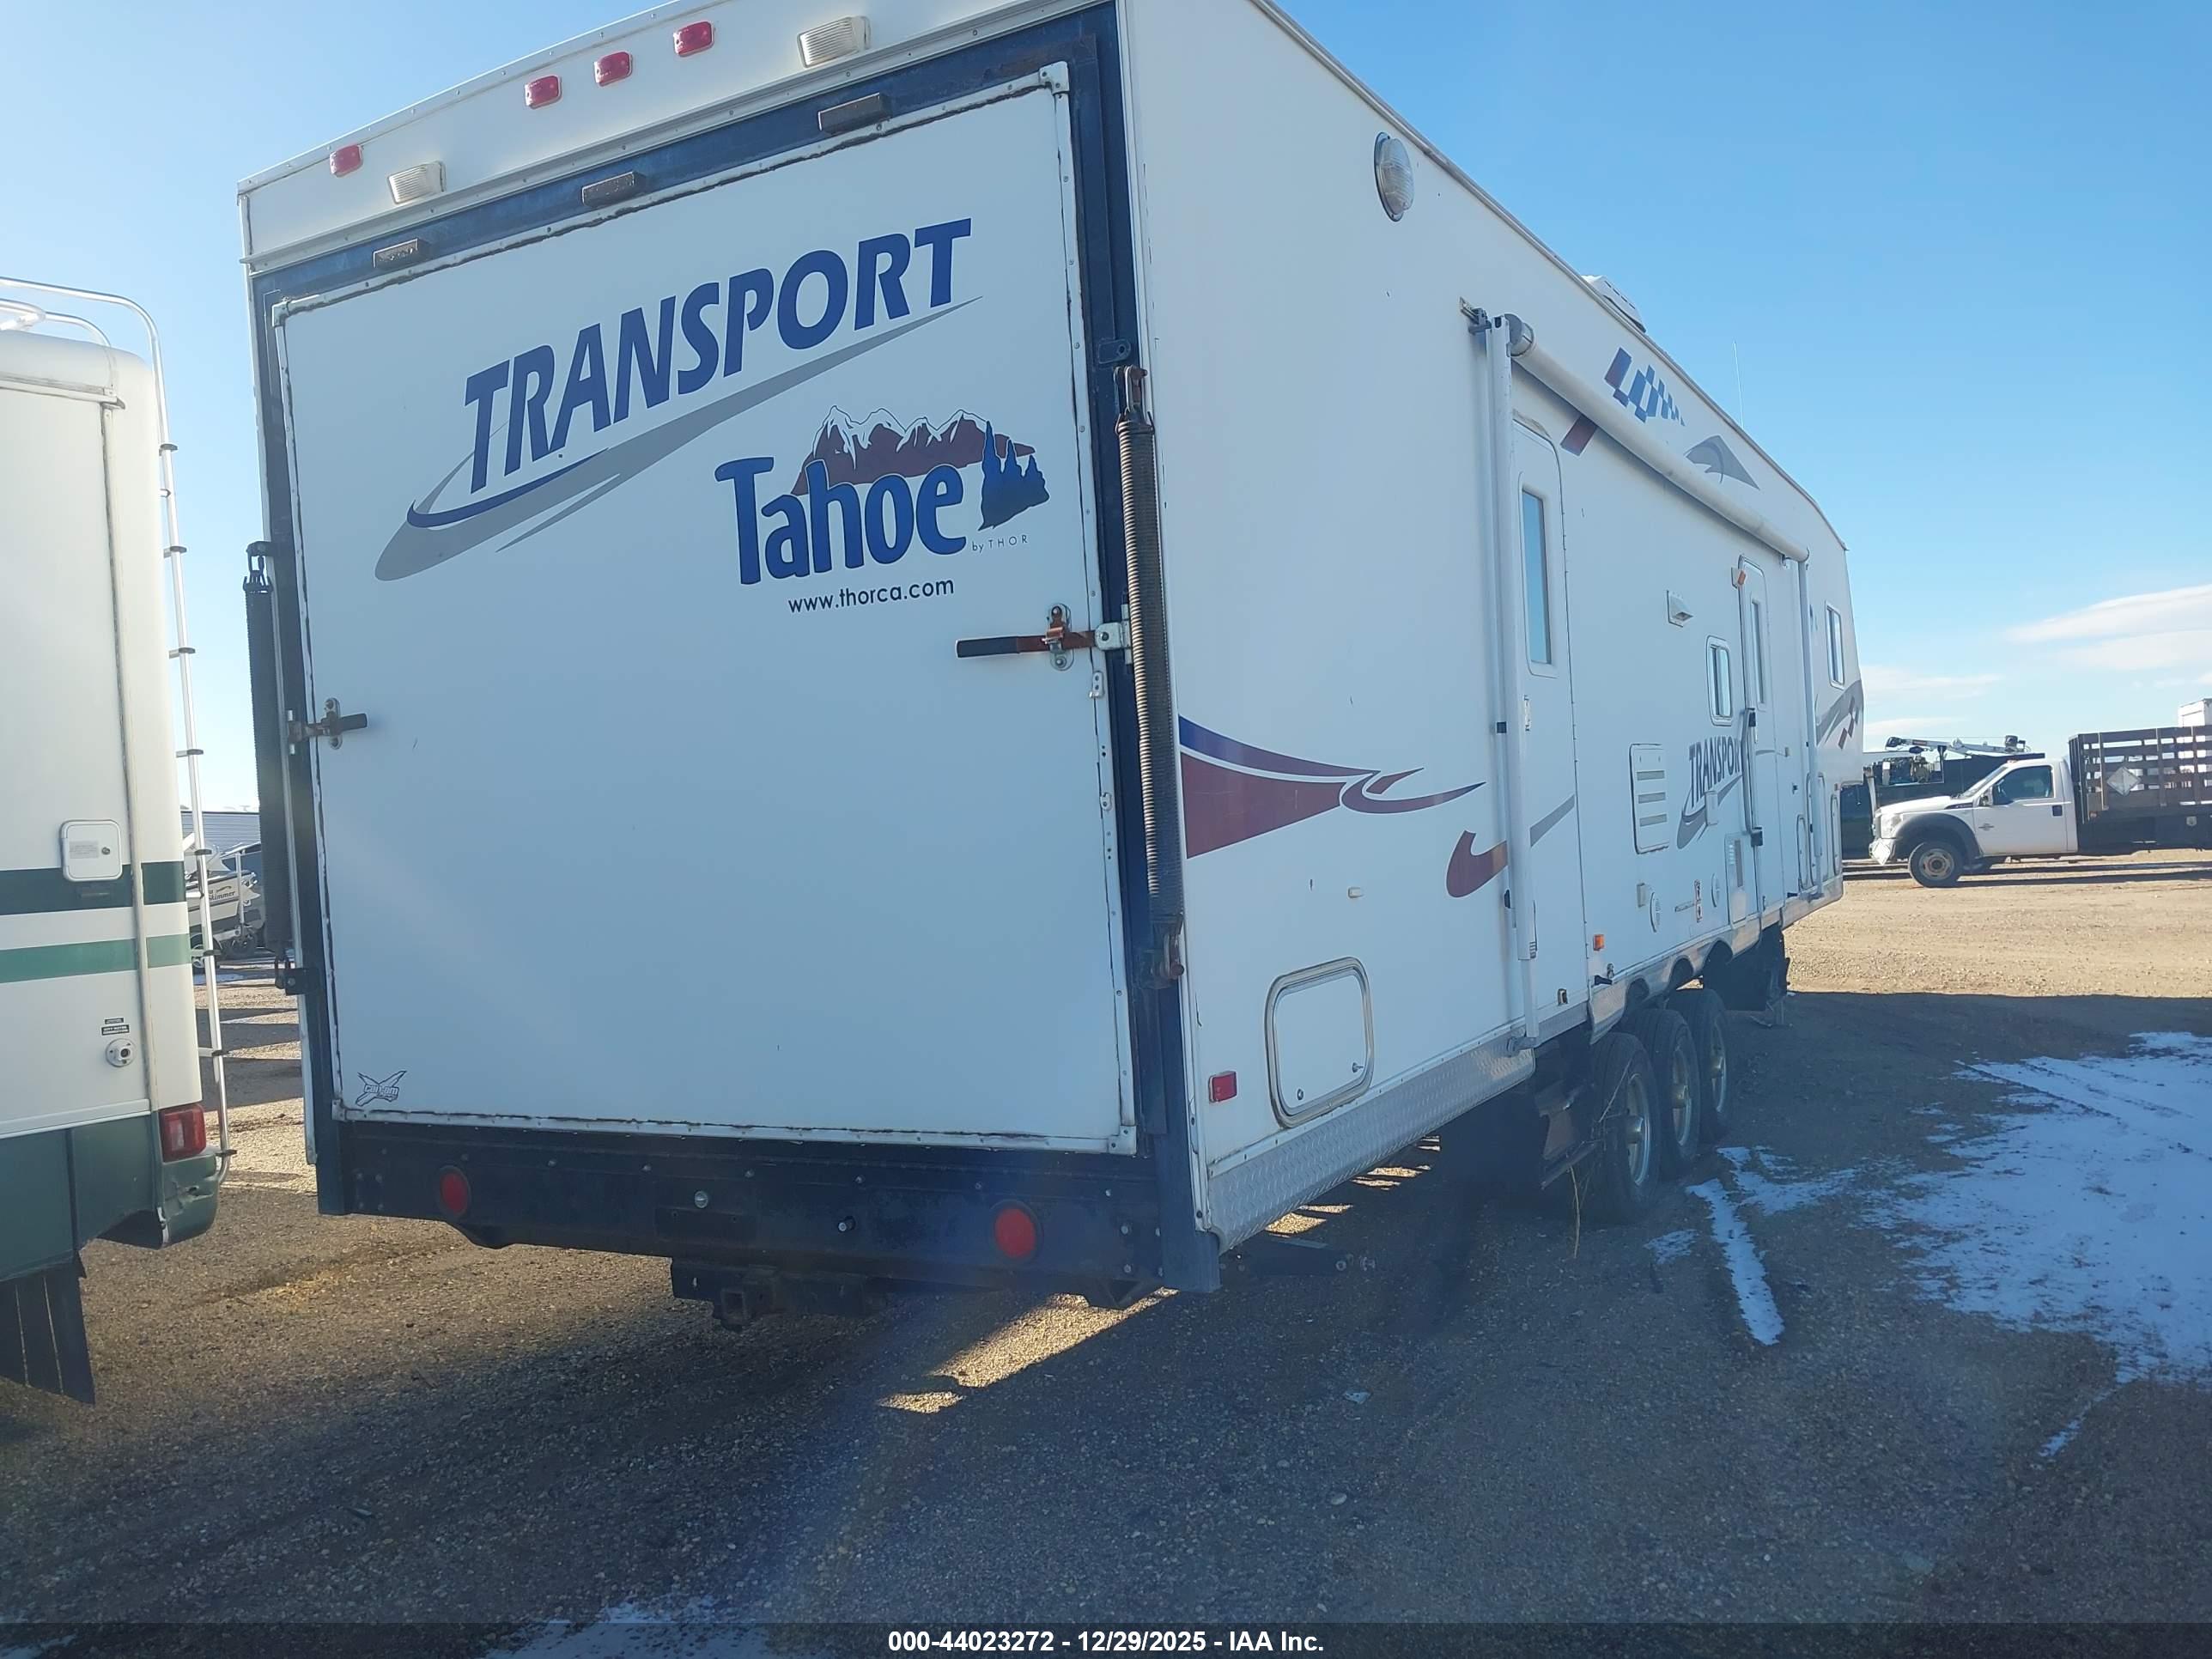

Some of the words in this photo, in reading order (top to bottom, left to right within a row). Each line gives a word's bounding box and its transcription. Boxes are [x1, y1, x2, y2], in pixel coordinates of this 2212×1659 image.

[465, 217, 972, 494] TRANSPORT
[714, 456, 967, 586] Tahoe
[972, 541, 984, 554] by
[988, 534, 1028, 549] THOR
[788, 579, 954, 613] www.thorca.com
[1689, 736, 1741, 809] TRANSPOR
